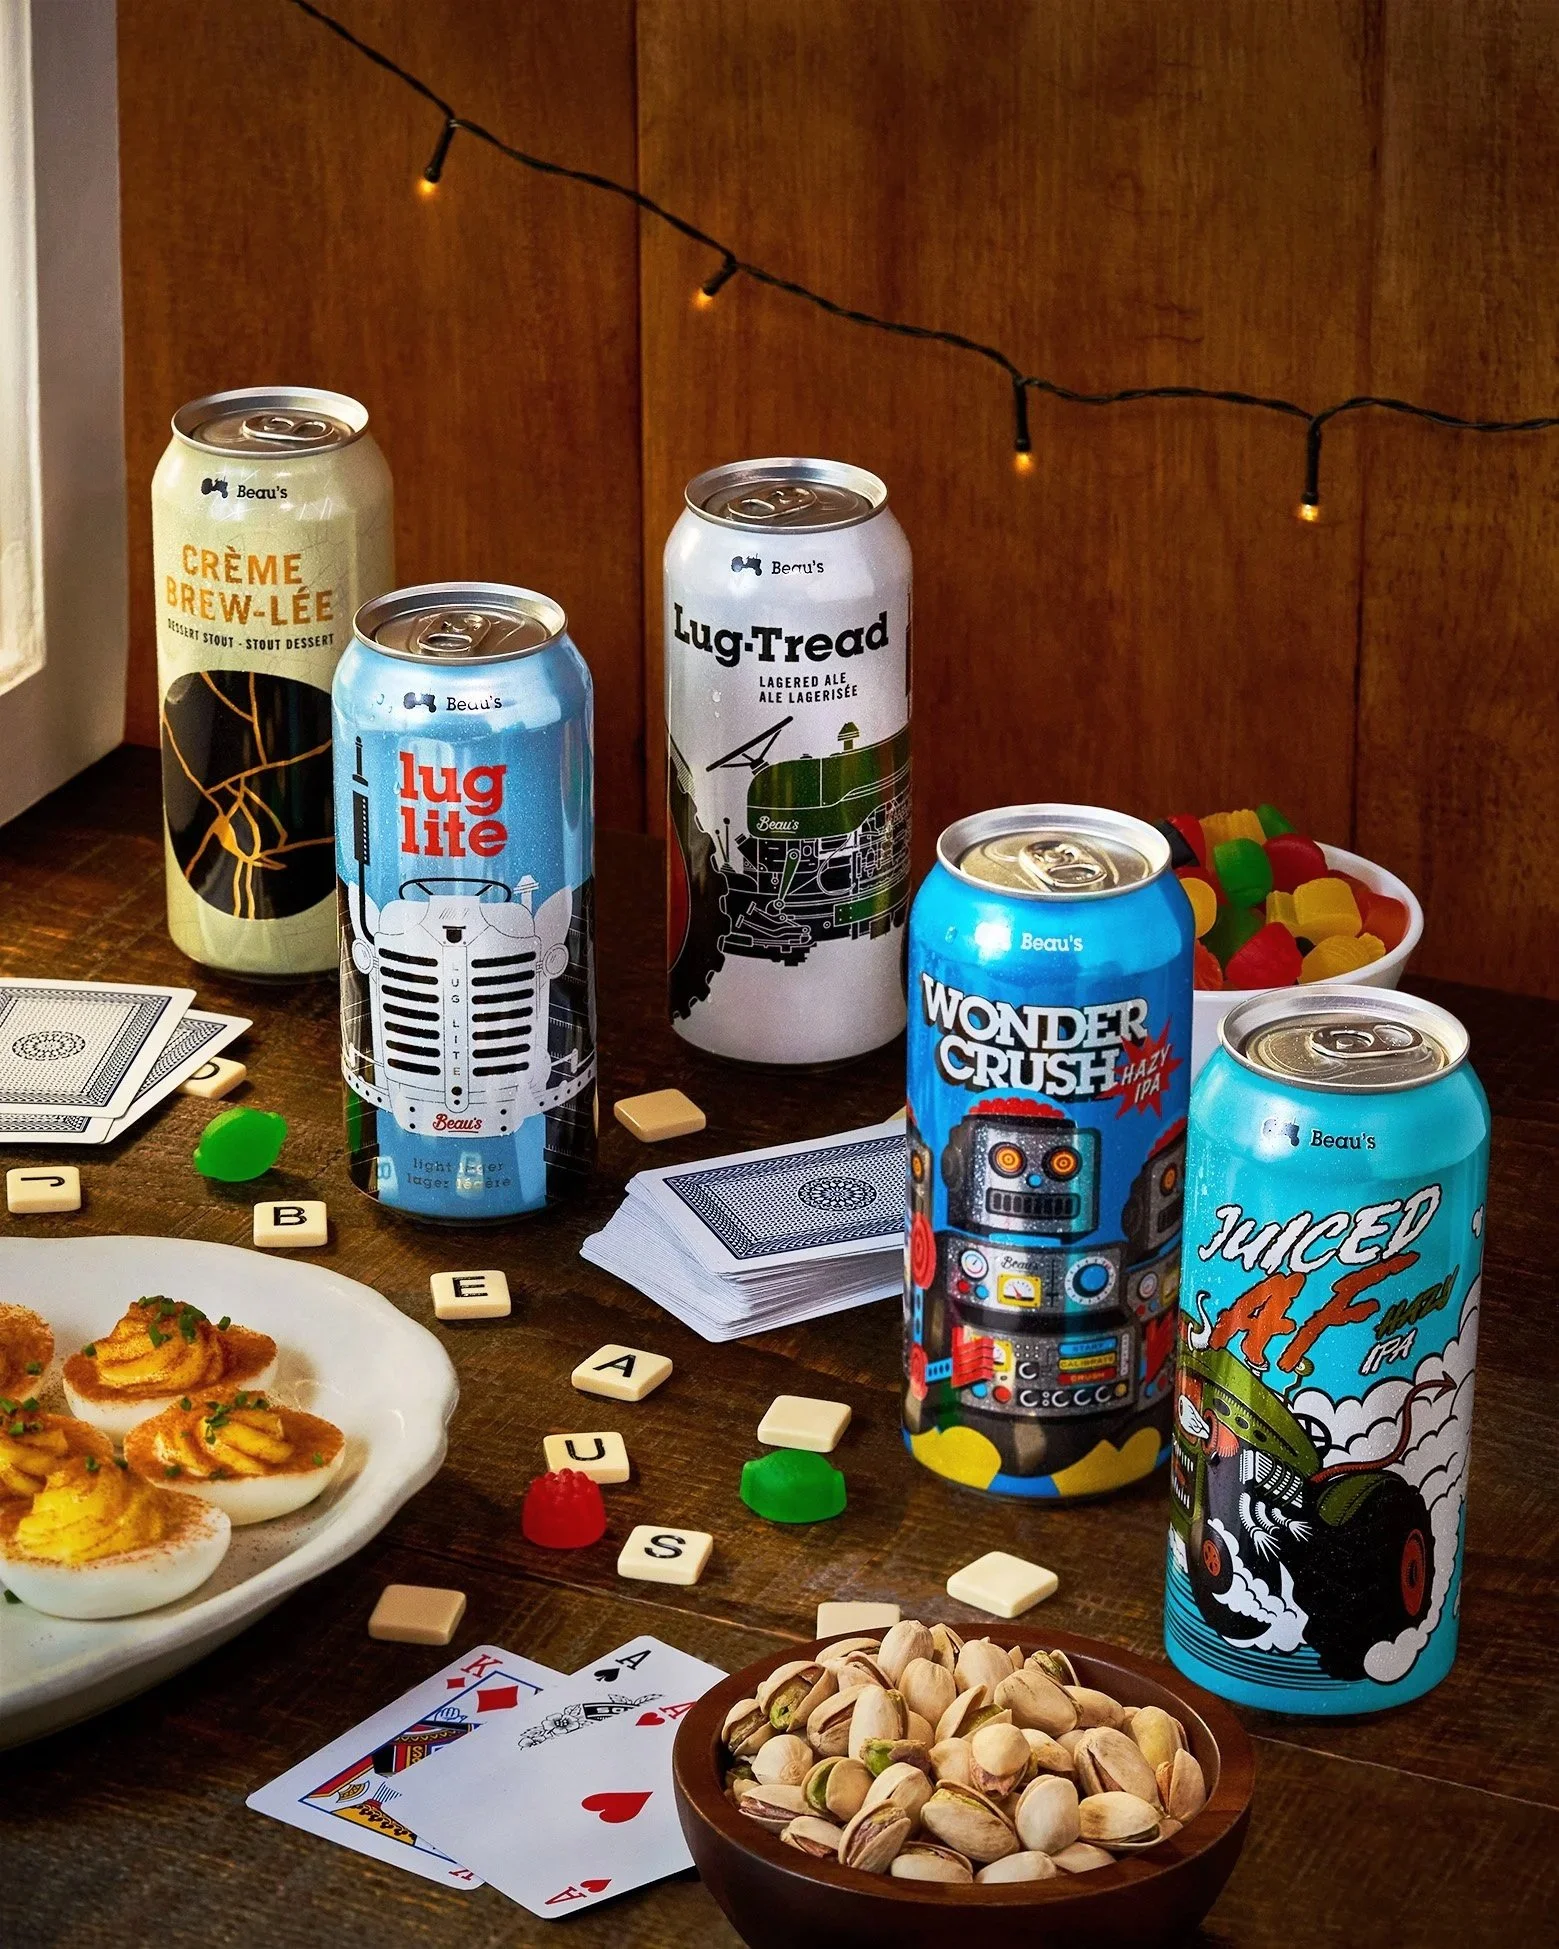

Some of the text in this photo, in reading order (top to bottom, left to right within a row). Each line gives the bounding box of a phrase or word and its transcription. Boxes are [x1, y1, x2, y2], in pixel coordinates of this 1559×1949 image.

[236, 484, 288, 499] Beau's
[182, 544, 303, 585] CRÈME
[771, 560, 824, 575] Beau's
[166, 575, 334, 626] BREW-LÉE
[168, 618, 199, 641] DESSERT
[203, 632, 234, 648] STOUT
[246, 639, 281, 651] STOUT
[286, 633, 335, 650] DESSERT
[673, 601, 889, 668] Lug-Tread
[759, 672, 847, 688] LAGERED ALE
[446, 696, 503, 711] Beau's
[759, 684, 858, 704] ALE LAGERISÉE
[399, 751, 508, 816] lug
[400, 805, 508, 858] lite
[756, 815, 799, 831] Beau's
[1020, 932, 1084, 952] Beau's
[922, 972, 1150, 1050] WONDER
[938, 1034, 1121, 1099] CRUSH
[1121, 1043, 1174, 1087] HAZY
[1134, 1072, 1161, 1104] IPA
[432, 1113, 482, 1132] Beau's
[1310, 1129, 1377, 1150] Beau's
[413, 1158, 452, 1173] light
[273, 1206, 307, 1227] B
[1198, 1183, 1443, 1275] JUICED
[451, 1275, 489, 1298] E
[1208, 1251, 1420, 1373] AF
[1360, 1328, 1418, 1376] IPA
[593, 1354, 637, 1378] A
[565, 1438, 607, 1461] U
[643, 1534, 686, 1559] S
[461, 1653, 504, 1678] K
[615, 1650, 652, 1670] A
[658, 1701, 697, 1720] A
[544, 1886, 588, 1905] A
